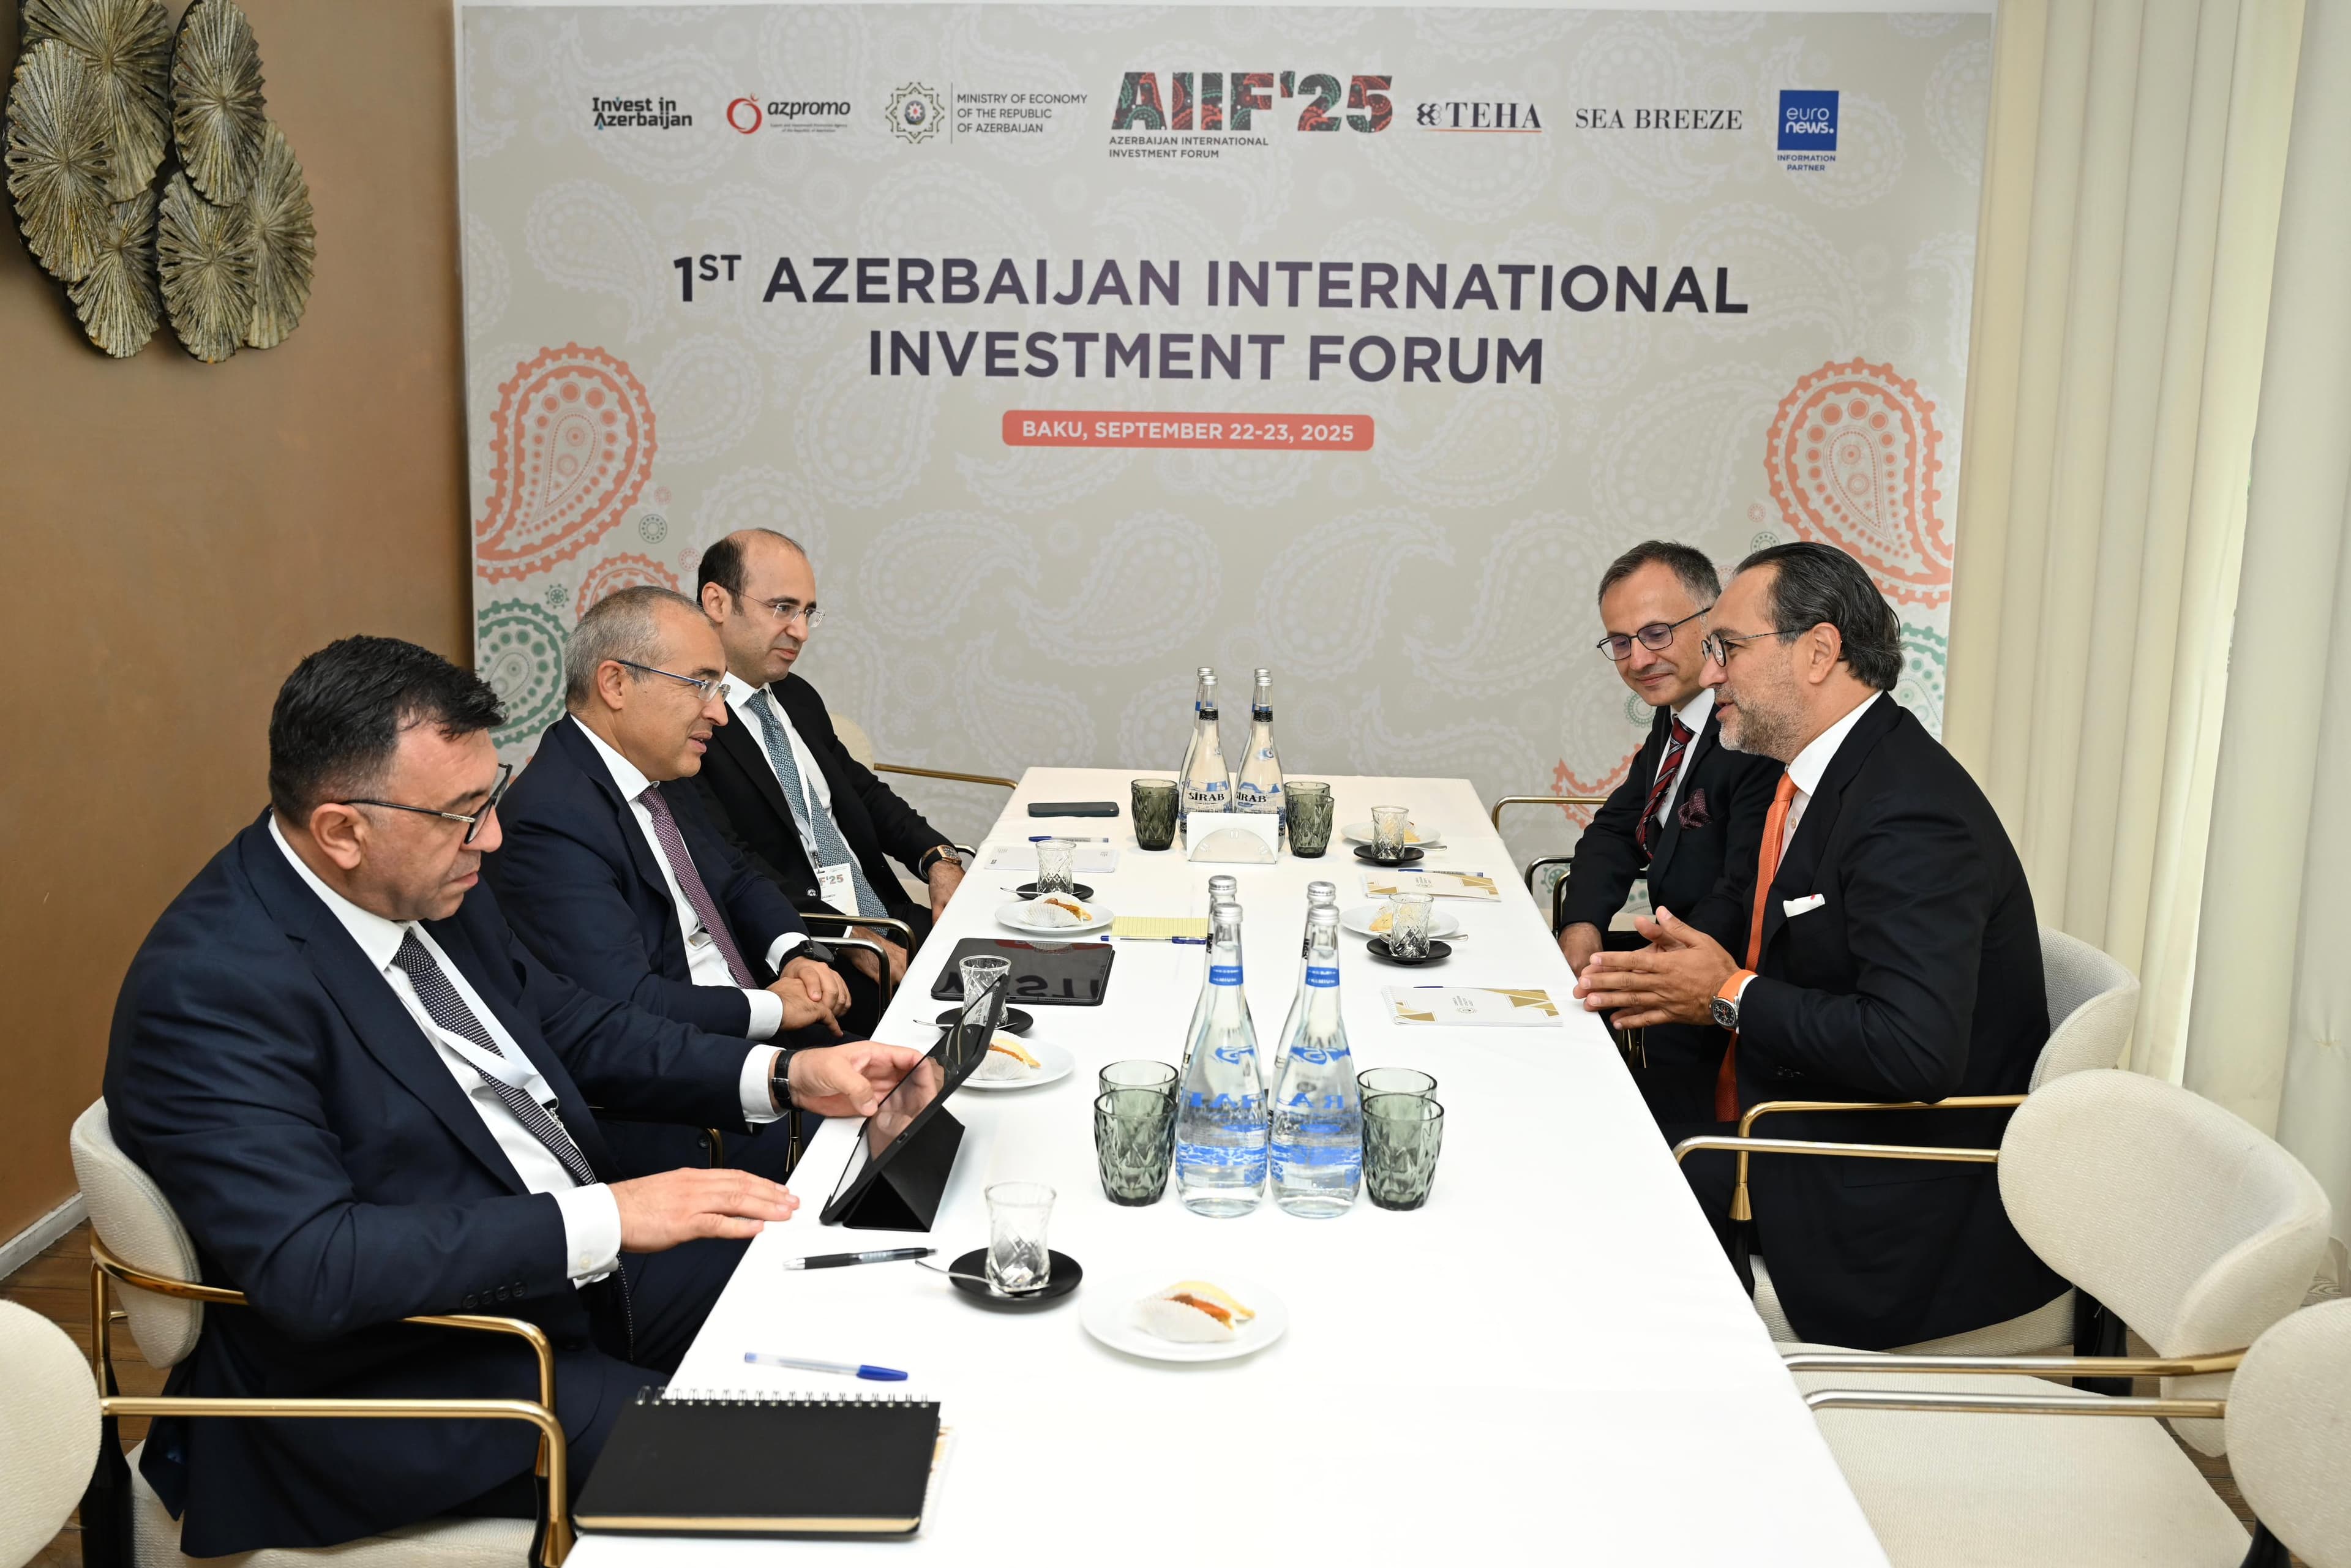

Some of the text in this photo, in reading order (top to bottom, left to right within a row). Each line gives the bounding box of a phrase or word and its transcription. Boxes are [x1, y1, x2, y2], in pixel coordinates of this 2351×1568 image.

[593, 97, 677, 111] Invest in
[957, 94, 1087, 104] MINISTRY OF ECONOMY
[1111, 70, 1393, 133] AIIF'25
[768, 102, 850, 119] azpromo
[957, 108, 1052, 119] OF THE REPUBLIC
[1445, 102, 1542, 129] TEHA
[1787, 107, 1829, 121] euro
[594, 112, 692, 130] Azerbaijan
[1575, 108, 1742, 130] SEA BREEZE
[957, 122, 1043, 133] OF AZERBAIJAN
[1785, 121, 1834, 134] news.
[1109, 137, 1269, 146] AZERBAIJAN INTERNATIONAL
[673, 253, 1749, 314] 1ST AZERBAIJAN INTERNATIONAL
[870, 330, 1543, 384] INVESTMENT FORUM
[1022, 421, 1354, 444] BAKU, SEPTEMBER 22-23, 2025
[819, 874, 844, 886] F'25
